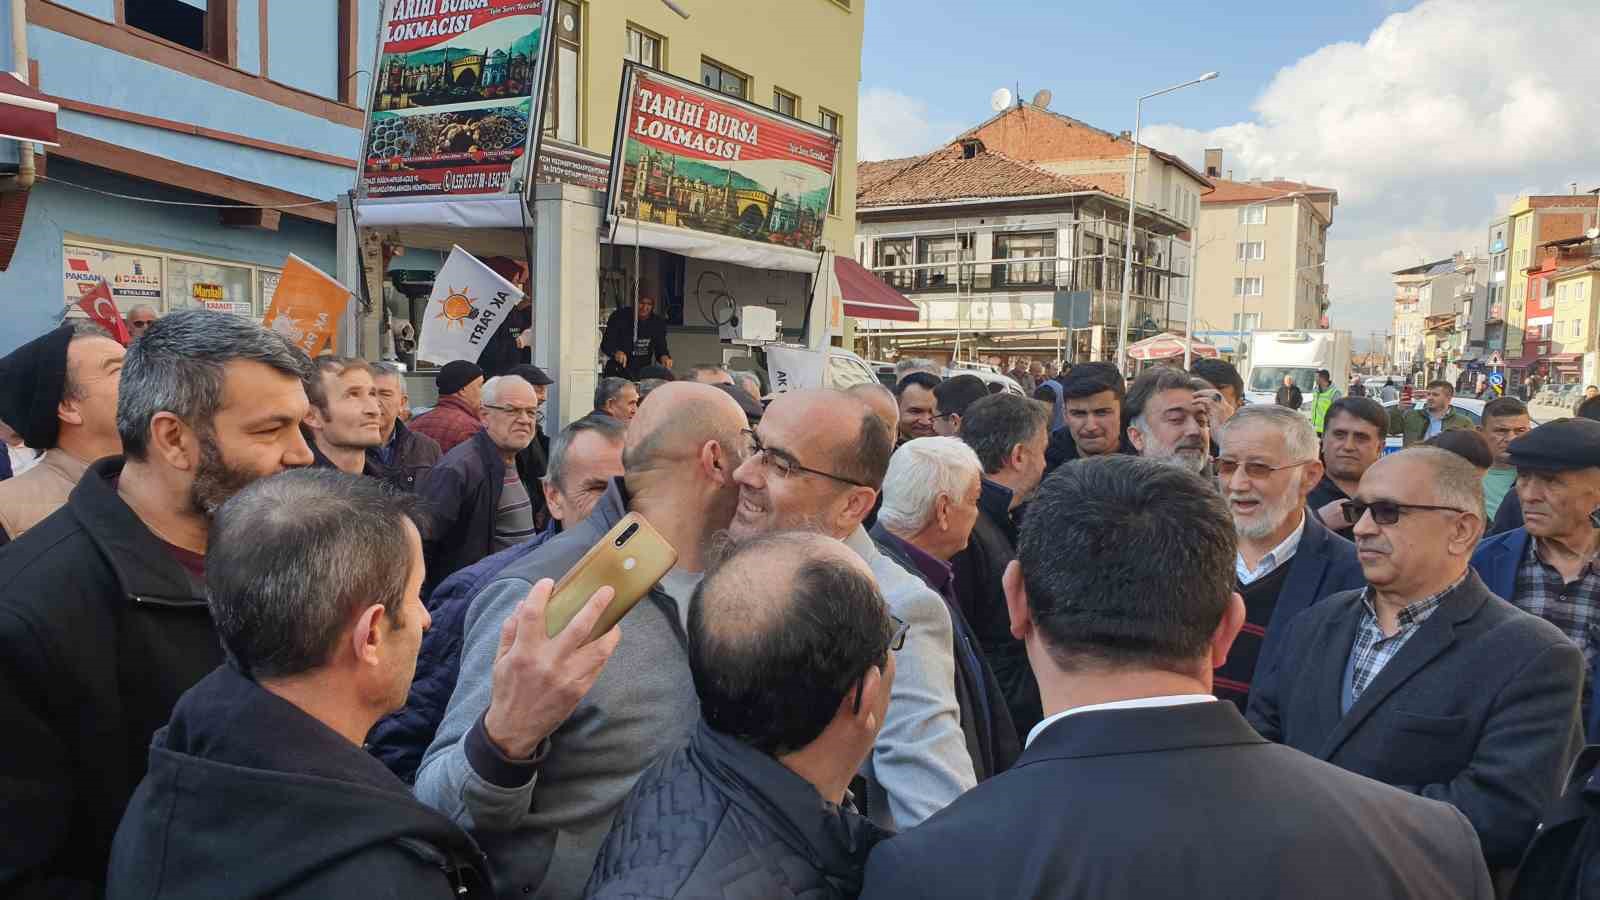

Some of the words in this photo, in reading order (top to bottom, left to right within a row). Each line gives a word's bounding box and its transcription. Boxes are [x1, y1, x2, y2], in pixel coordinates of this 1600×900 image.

[385, 14, 474, 43] LOKMACISI
[639, 88, 704, 128] TARİHİ
[706, 110, 758, 145] BURSA
[634, 116, 741, 160] LOKMACISI
[124, 274, 159, 284] DAMLA
[193, 285, 224, 298] Marshall
[776, 370, 788, 386] AK
